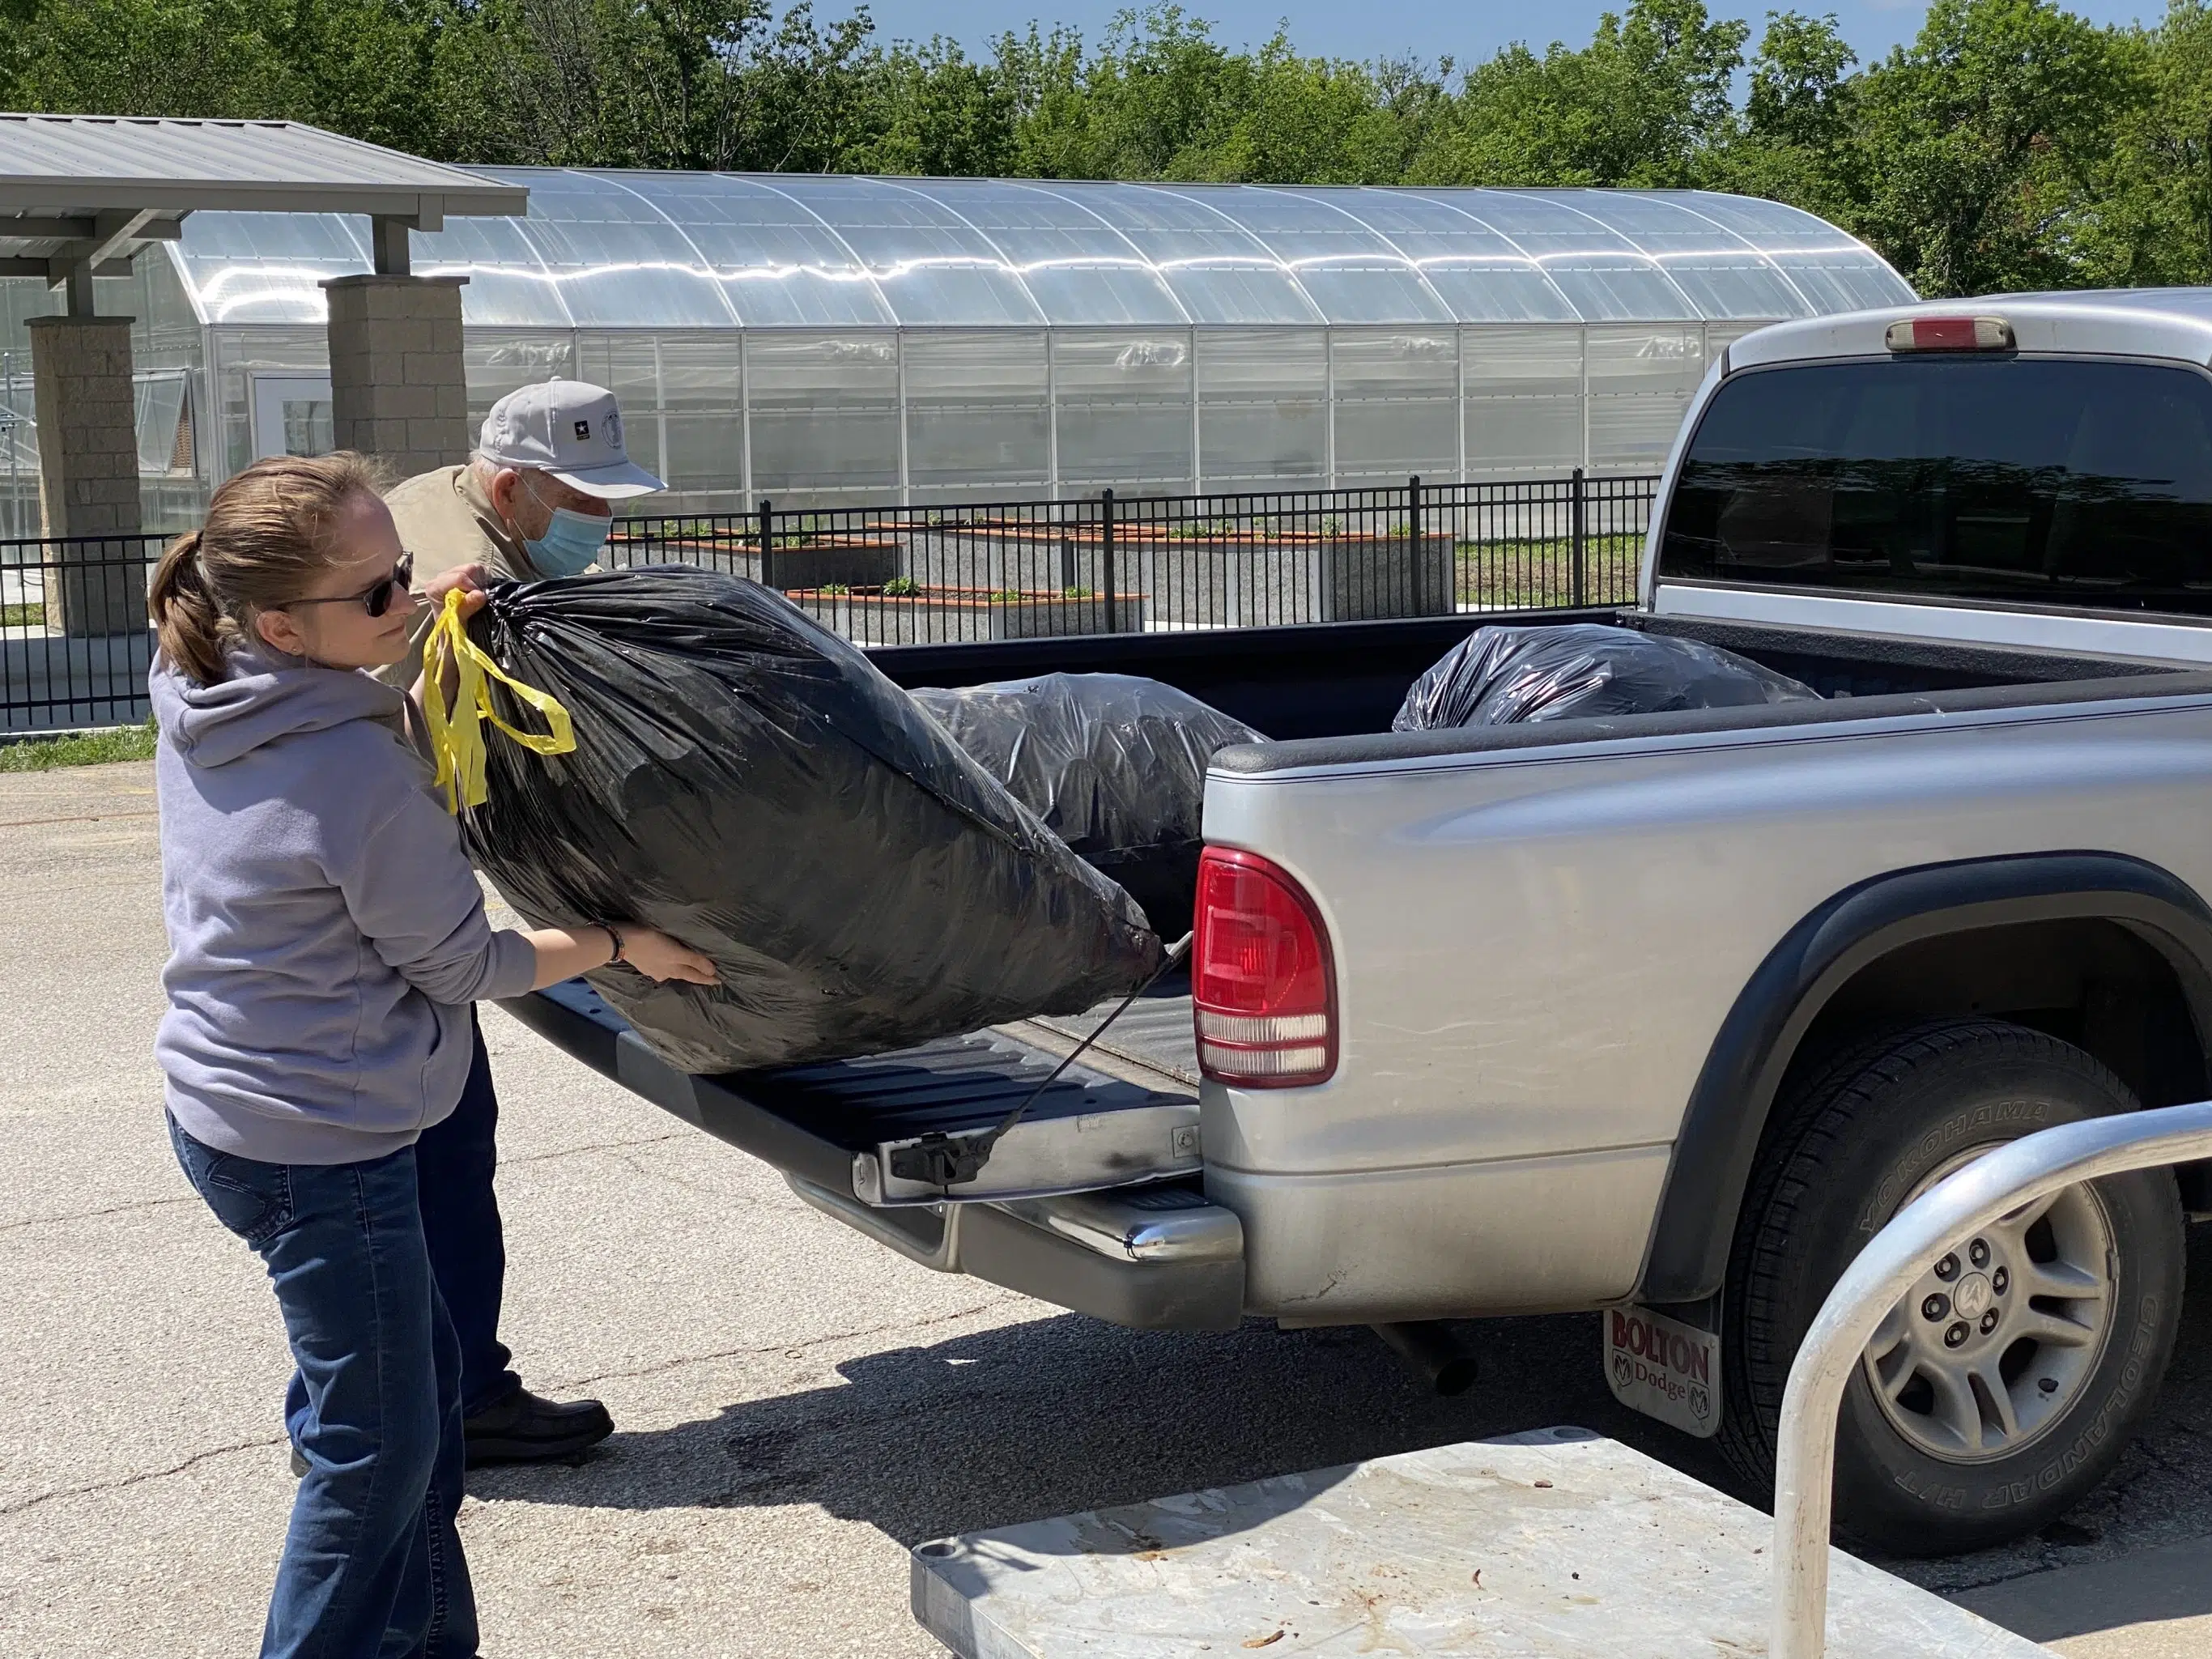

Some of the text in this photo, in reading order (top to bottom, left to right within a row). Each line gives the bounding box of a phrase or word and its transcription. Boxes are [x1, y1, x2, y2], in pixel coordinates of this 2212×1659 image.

[1859, 1098, 2054, 1232] YOKOHAMA
[1612, 1309, 1709, 1385] BOLTON
[1635, 1363, 1686, 1401] Dodge
[1980, 1295, 2160, 1510] GEOLANDAR
